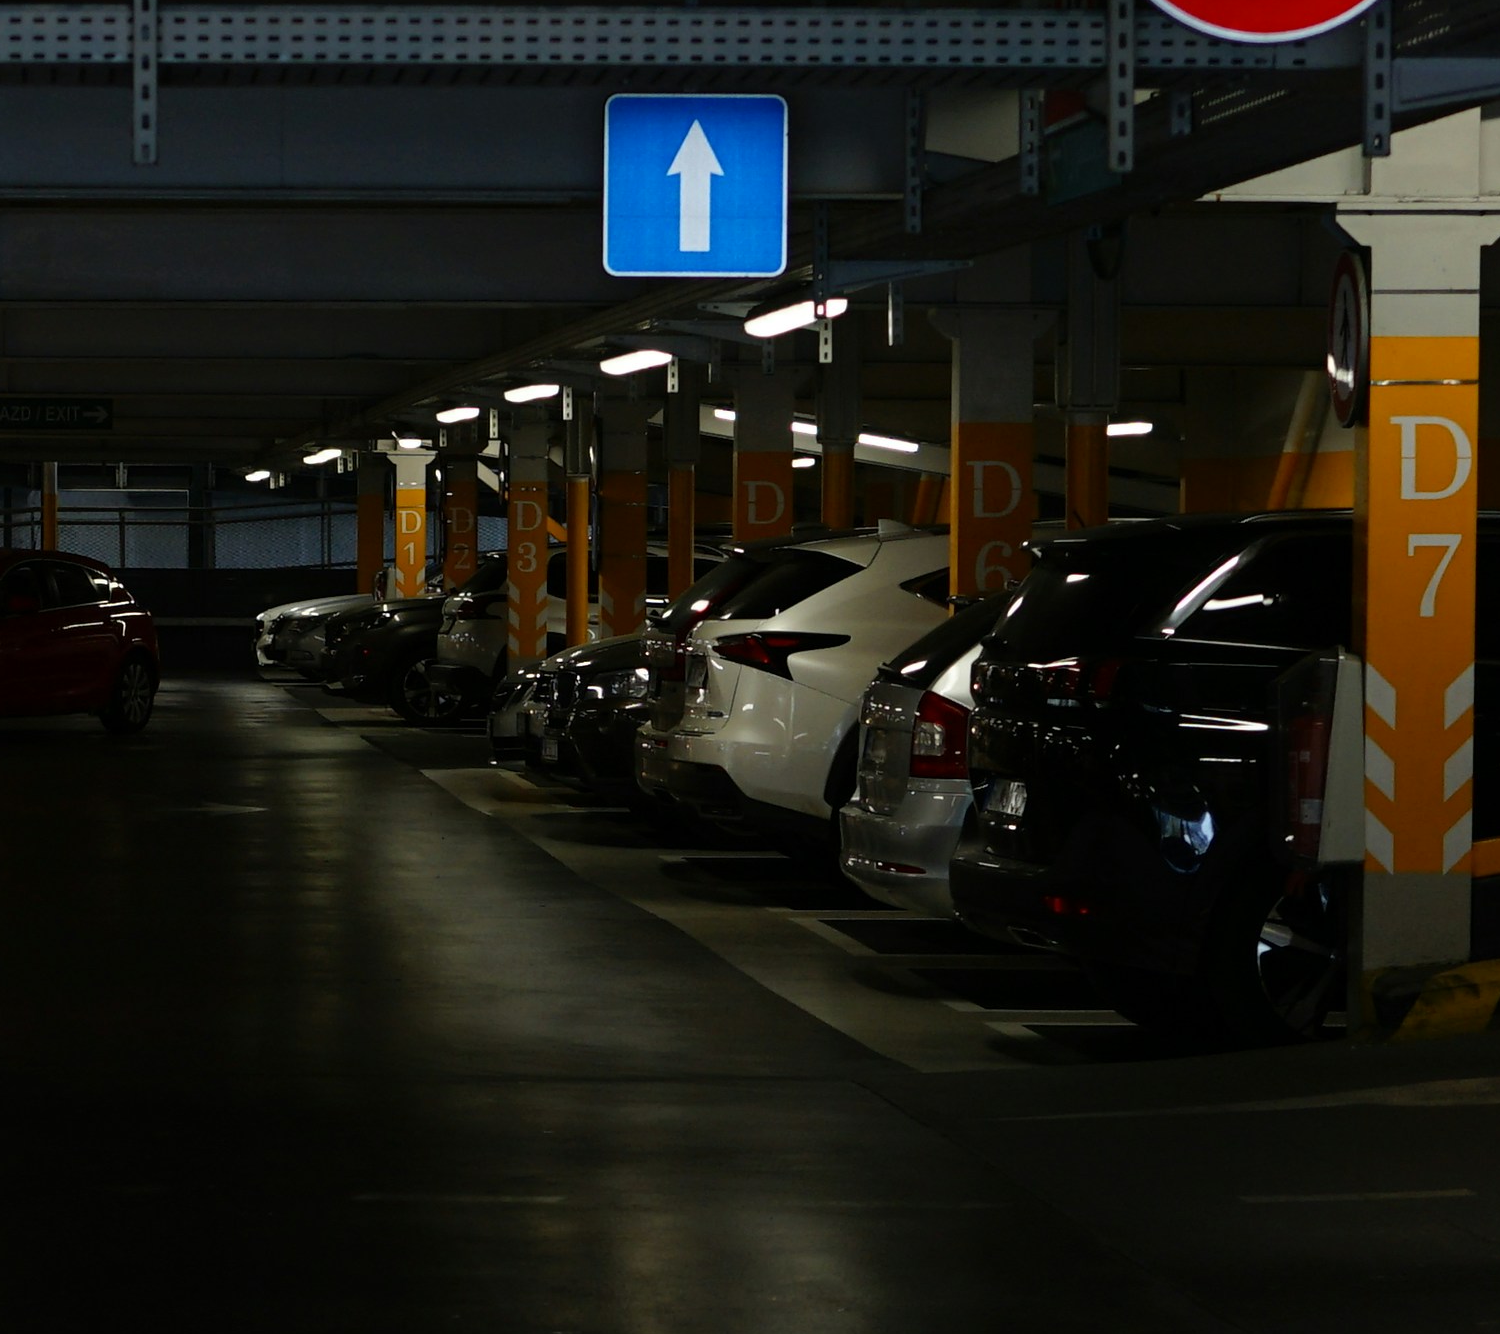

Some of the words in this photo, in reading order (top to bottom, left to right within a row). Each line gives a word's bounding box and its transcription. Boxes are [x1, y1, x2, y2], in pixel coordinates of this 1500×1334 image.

[45, 405, 81, 422] EXIT
[1388, 415, 1473, 501] D
[742, 480, 785, 525] D
[966, 460, 1023, 519] D
[398, 510, 422, 534] D
[450, 507, 475, 534] D
[513, 500, 543, 531] D
[403, 542, 415, 566] 1
[453, 542, 471, 570] 2
[516, 541, 537, 573] 3
[974, 540, 1013, 593] 6
[1407, 534, 1463, 618] 7
